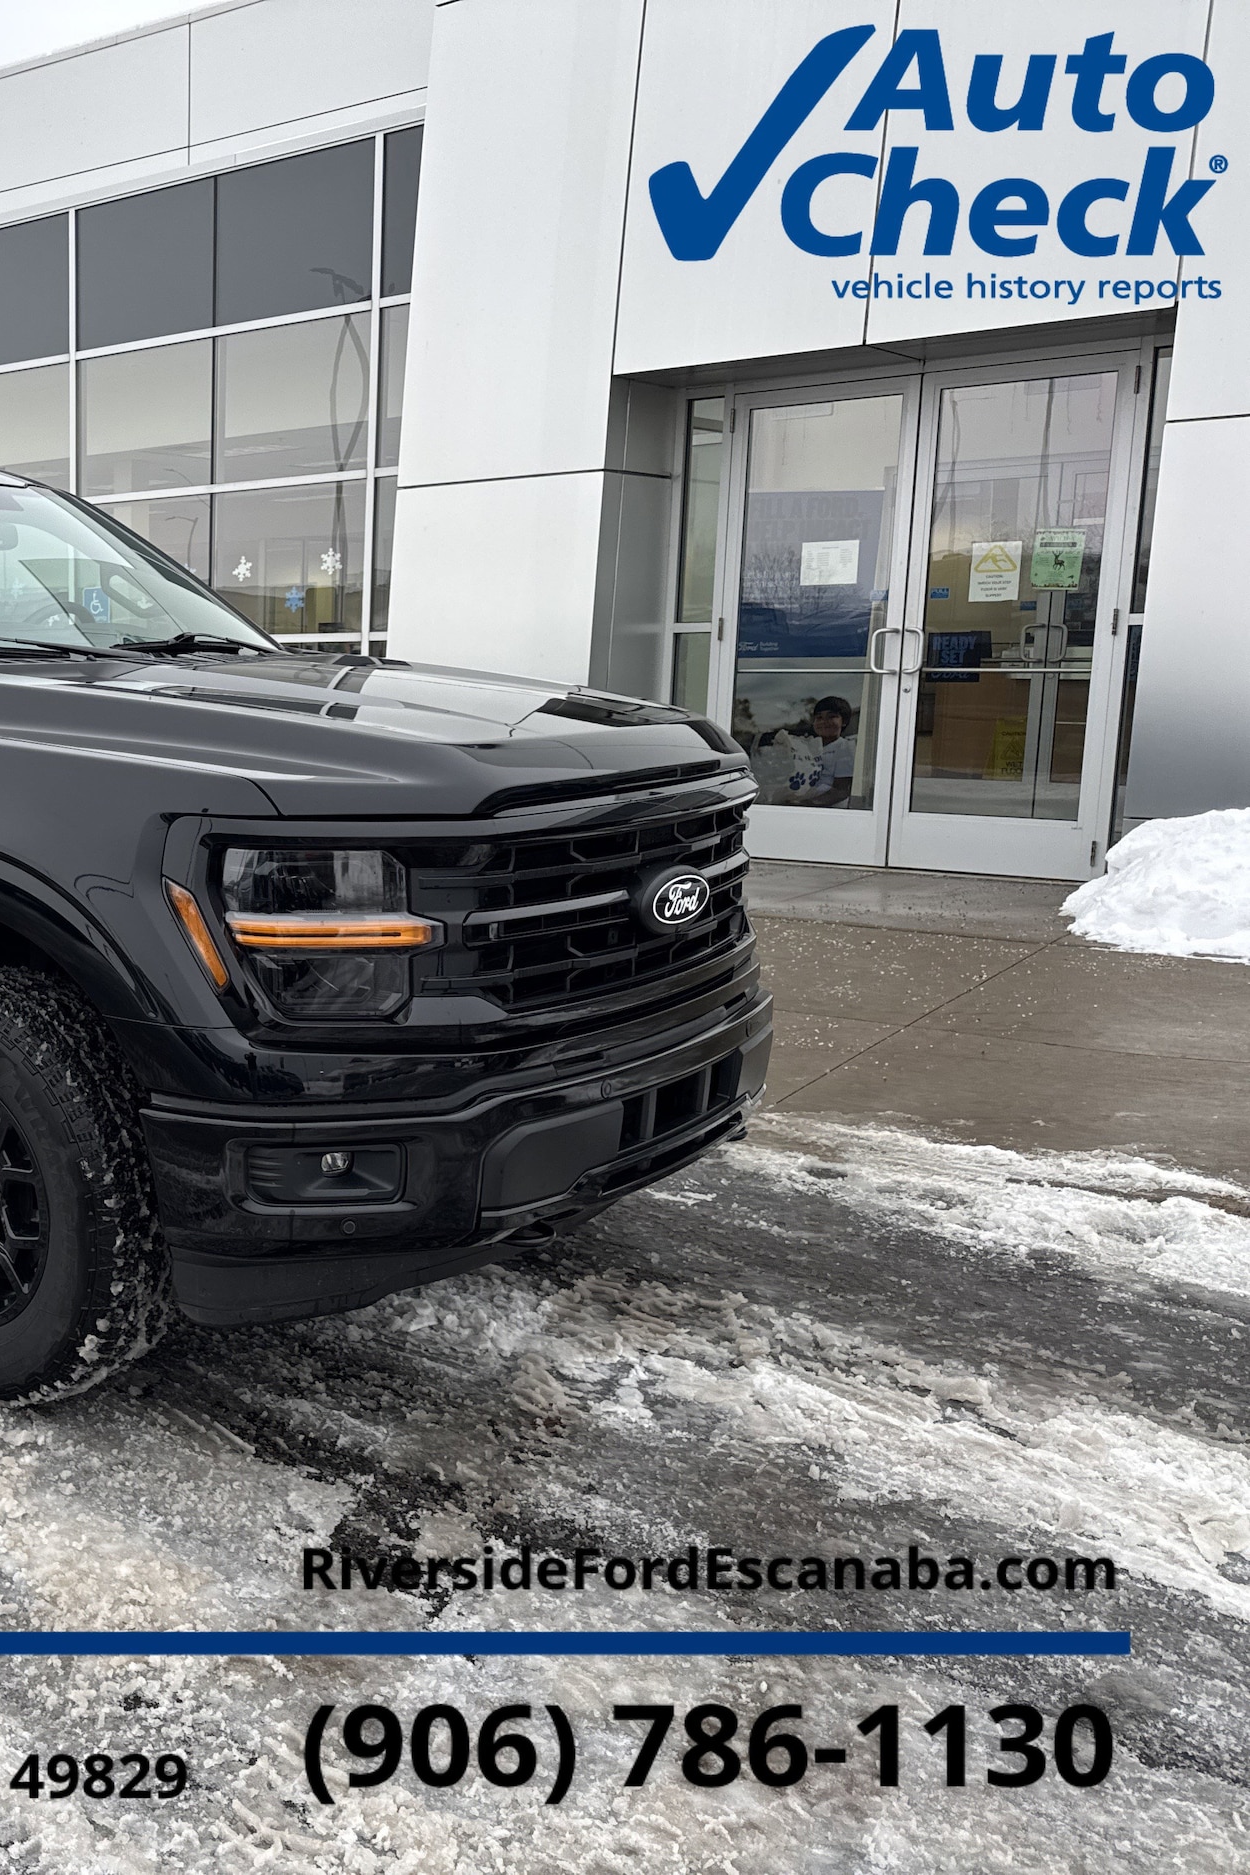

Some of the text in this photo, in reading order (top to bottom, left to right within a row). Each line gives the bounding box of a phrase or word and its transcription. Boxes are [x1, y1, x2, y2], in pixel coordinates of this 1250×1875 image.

[932, 636, 977, 650] READY
[940, 650, 966, 664] SET
[664, 881, 700, 917] Ford
